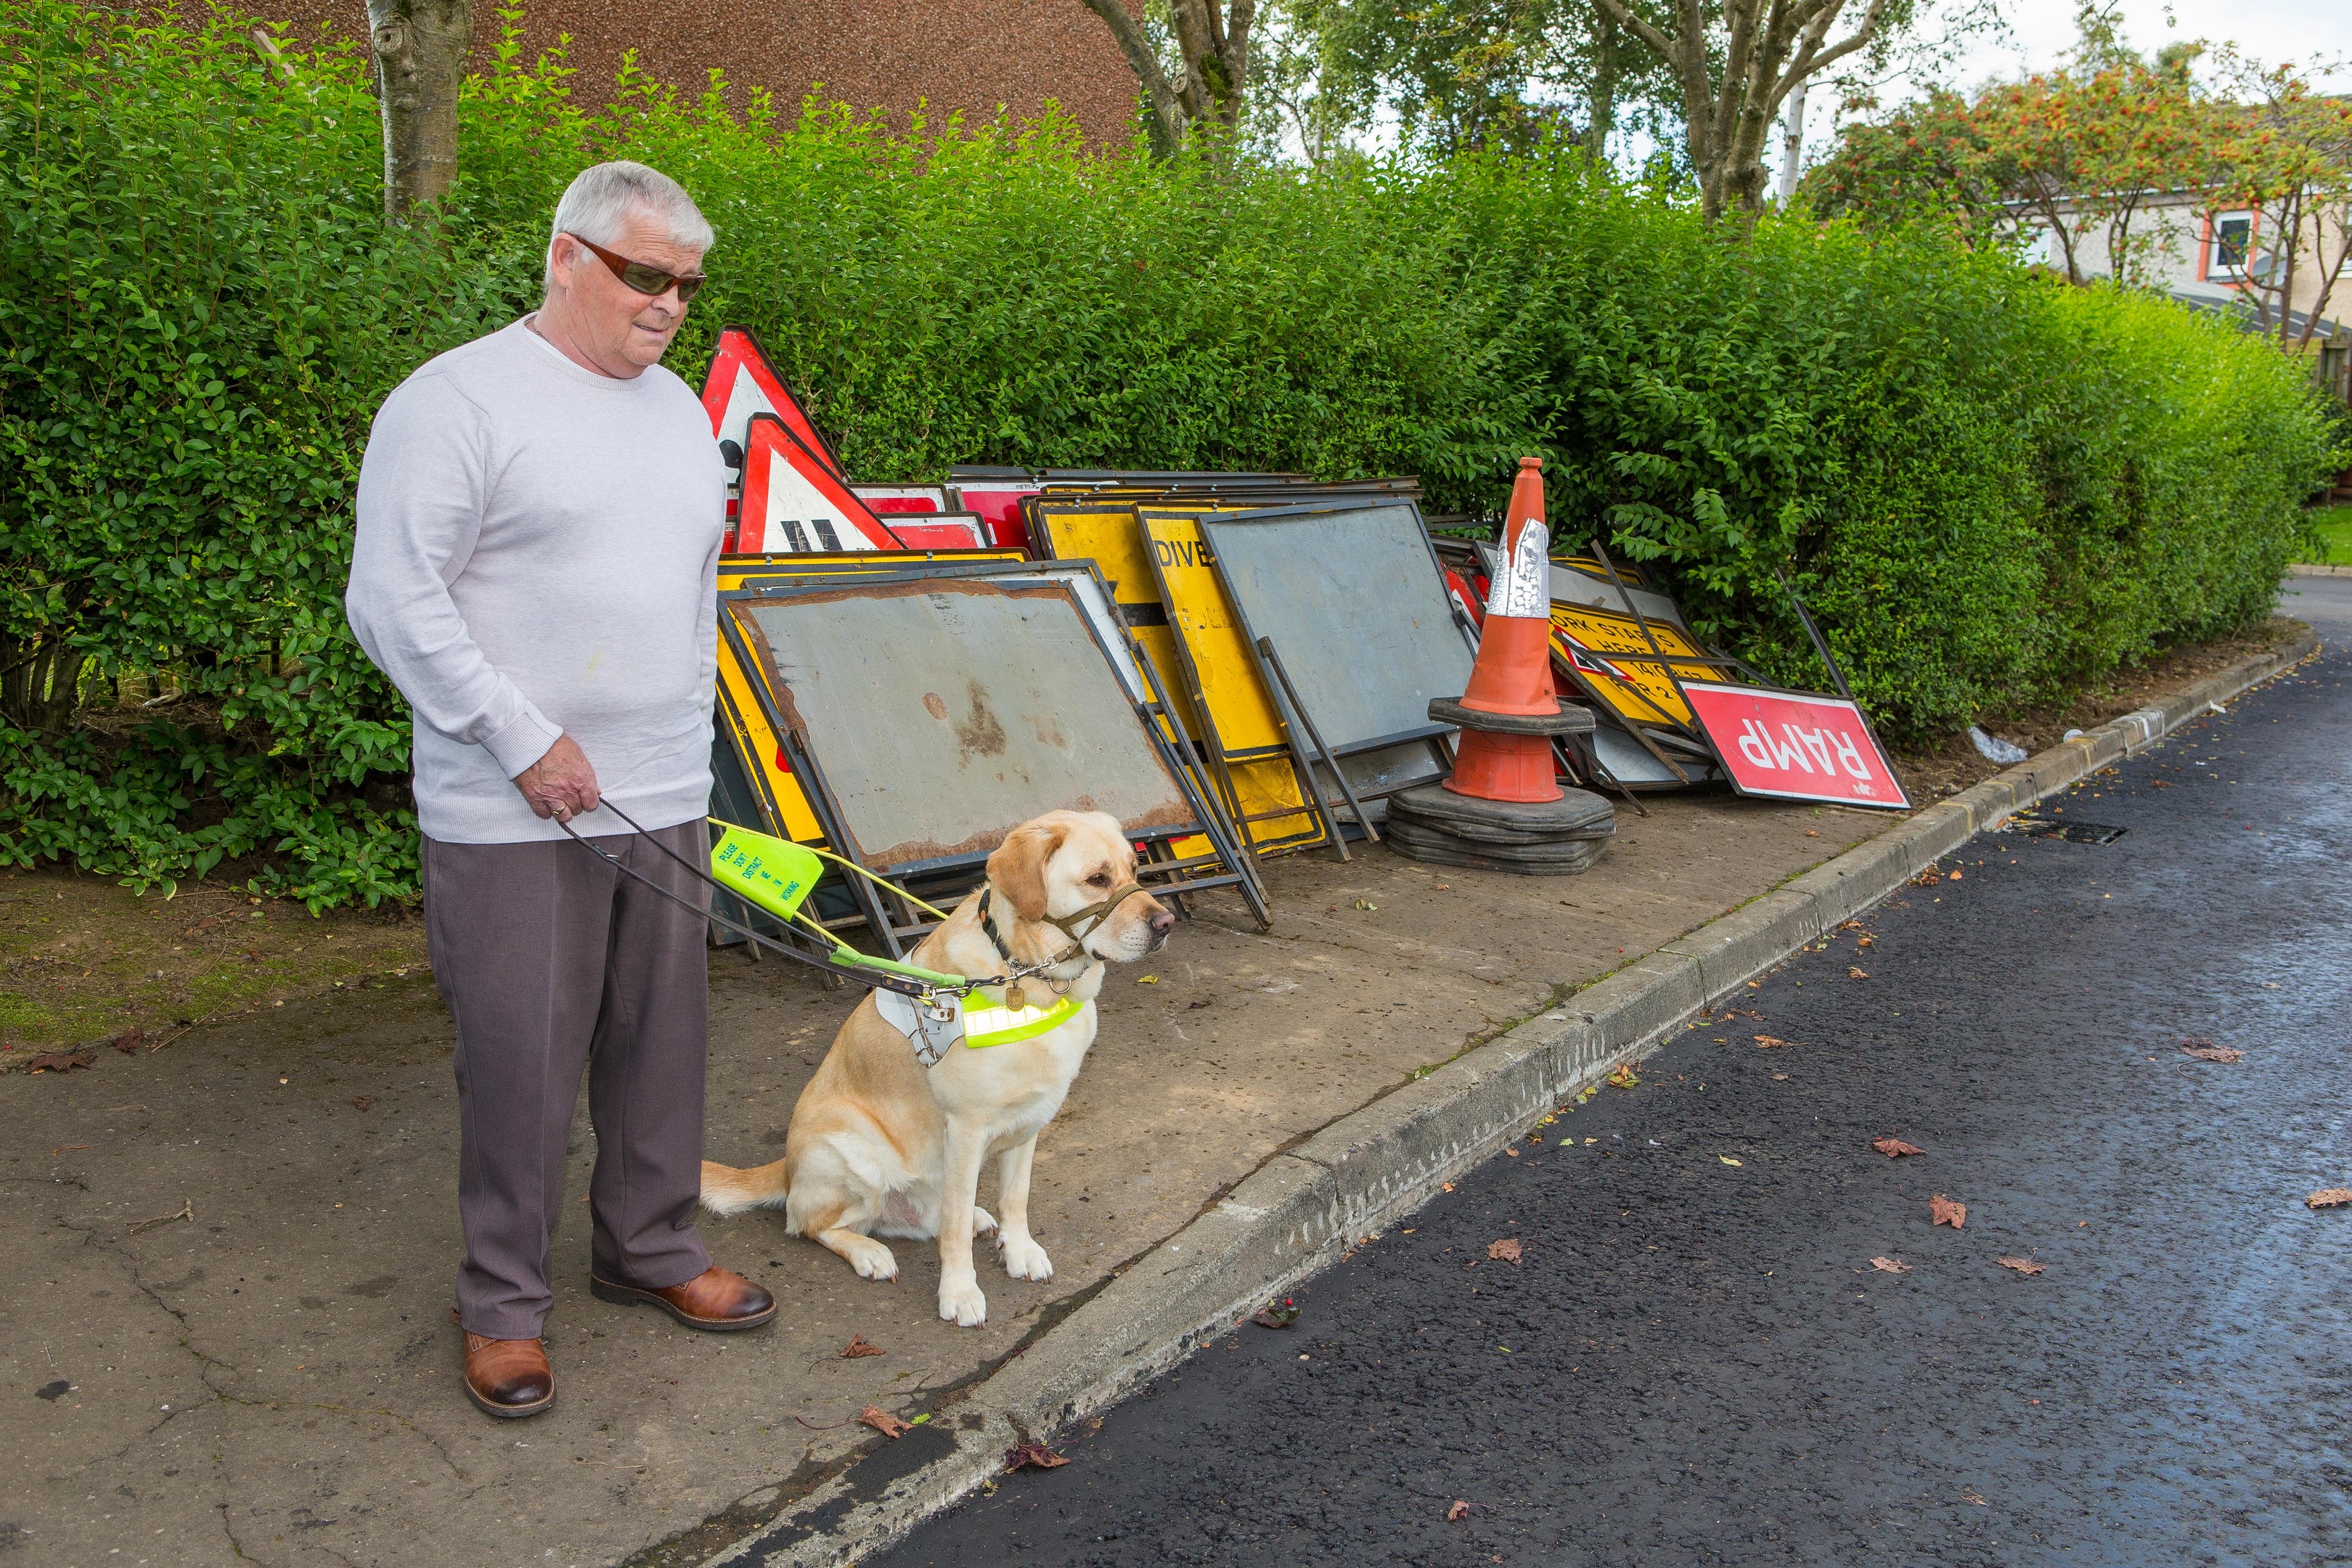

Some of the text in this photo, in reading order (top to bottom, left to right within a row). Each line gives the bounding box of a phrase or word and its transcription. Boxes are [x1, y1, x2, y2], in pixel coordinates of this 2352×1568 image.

[1548, 613, 1598, 634] ORK
[1739, 718, 1873, 780] RAMP
[719, 842, 738, 862] PLEASE
[742, 857, 764, 879] DISTRACT
[760, 870, 771, 880] ME
[780, 881, 800, 901] WORKING
